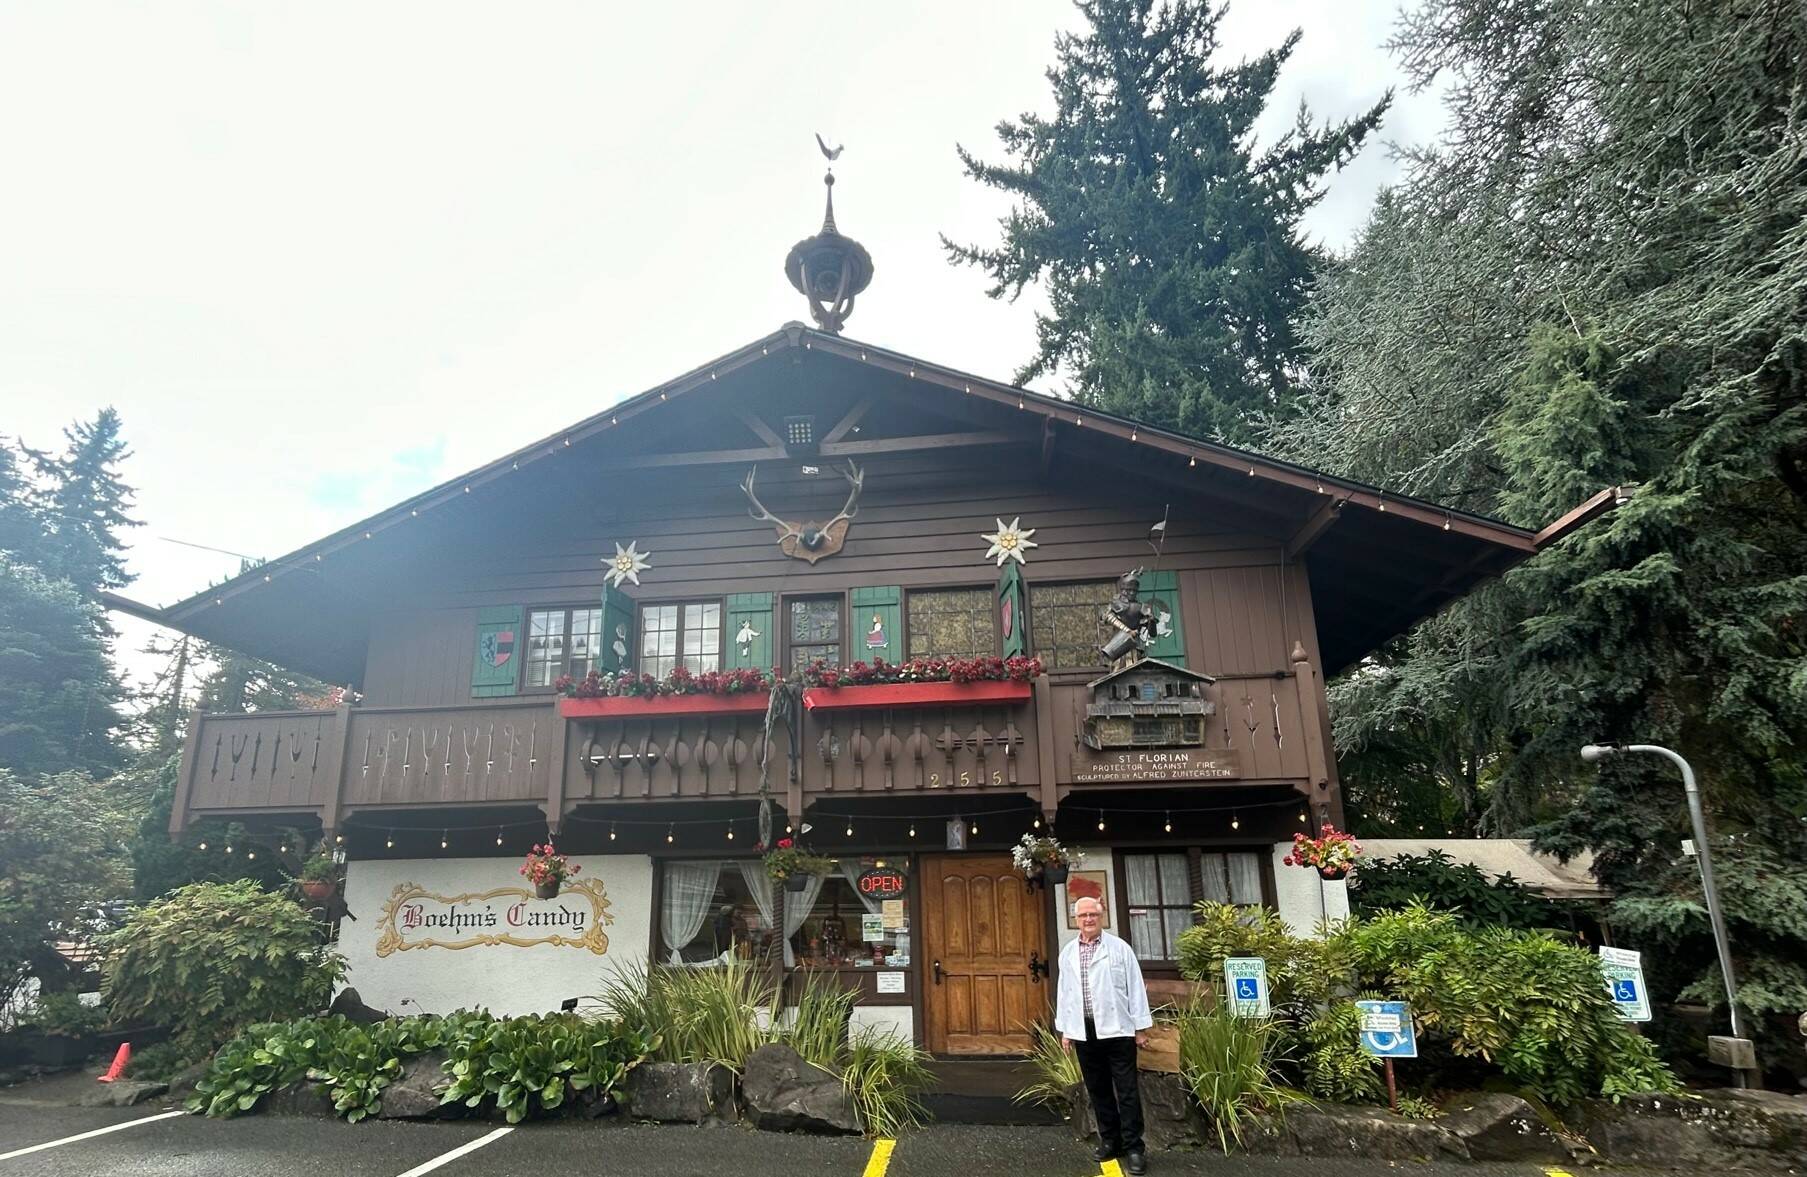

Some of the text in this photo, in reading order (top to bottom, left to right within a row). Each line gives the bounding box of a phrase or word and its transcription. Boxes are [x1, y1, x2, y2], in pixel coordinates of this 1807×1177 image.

[1118, 753, 1189, 763] ST FLORIAN
[1092, 761, 1216, 772] PROTECTOR AGAINST FIRE
[1132, 771, 1166, 779] ALFRED
[861, 876, 903, 892] OPEN
[400, 902, 586, 935] Boehm's Candy
[1228, 962, 1262, 971] RESERVED
[1232, 970, 1260, 978] PARKING
